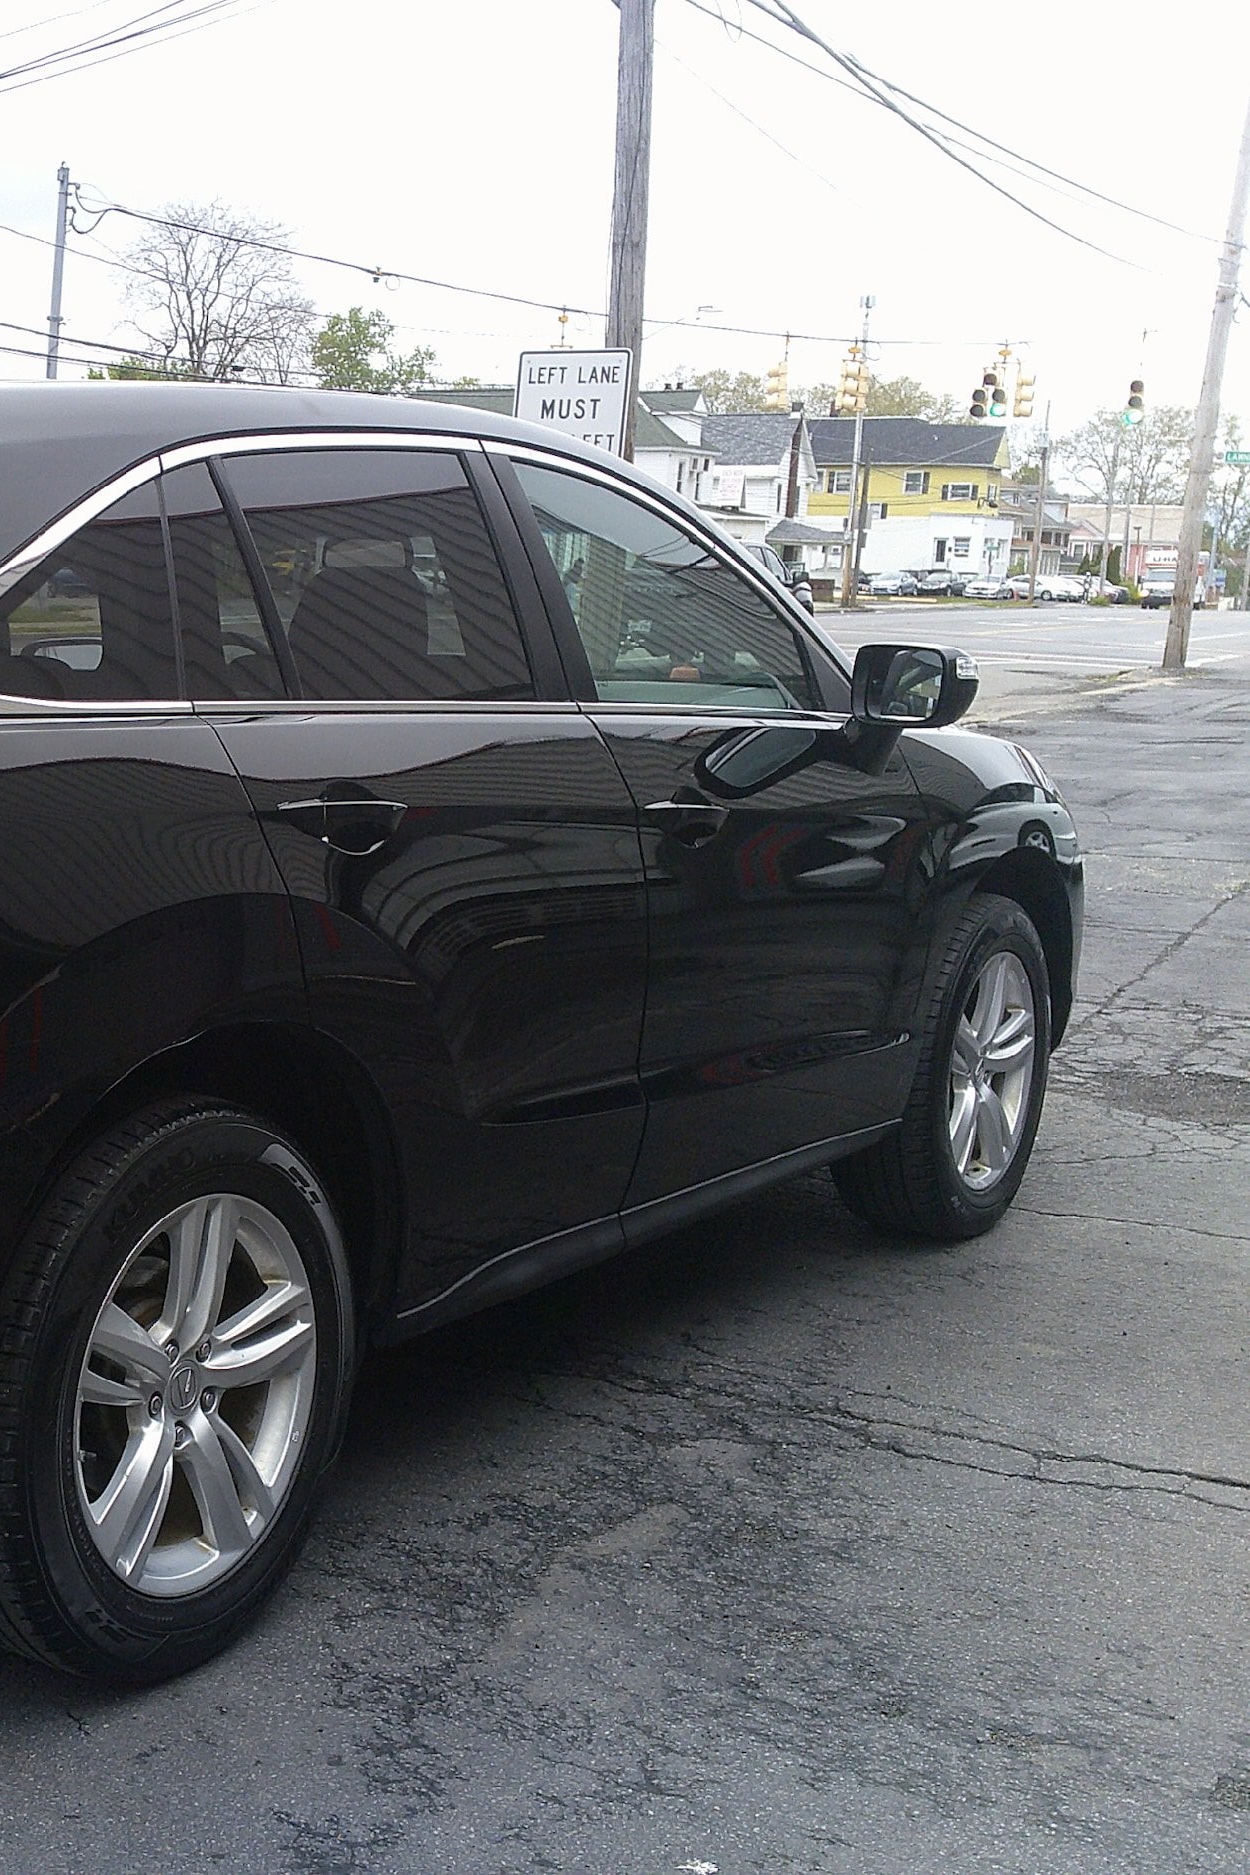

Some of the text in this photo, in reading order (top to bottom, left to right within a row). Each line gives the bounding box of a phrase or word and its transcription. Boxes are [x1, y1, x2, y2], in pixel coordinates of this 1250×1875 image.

[528, 366, 620, 384] LEFT LANE
[541, 399, 601, 419] MUST
